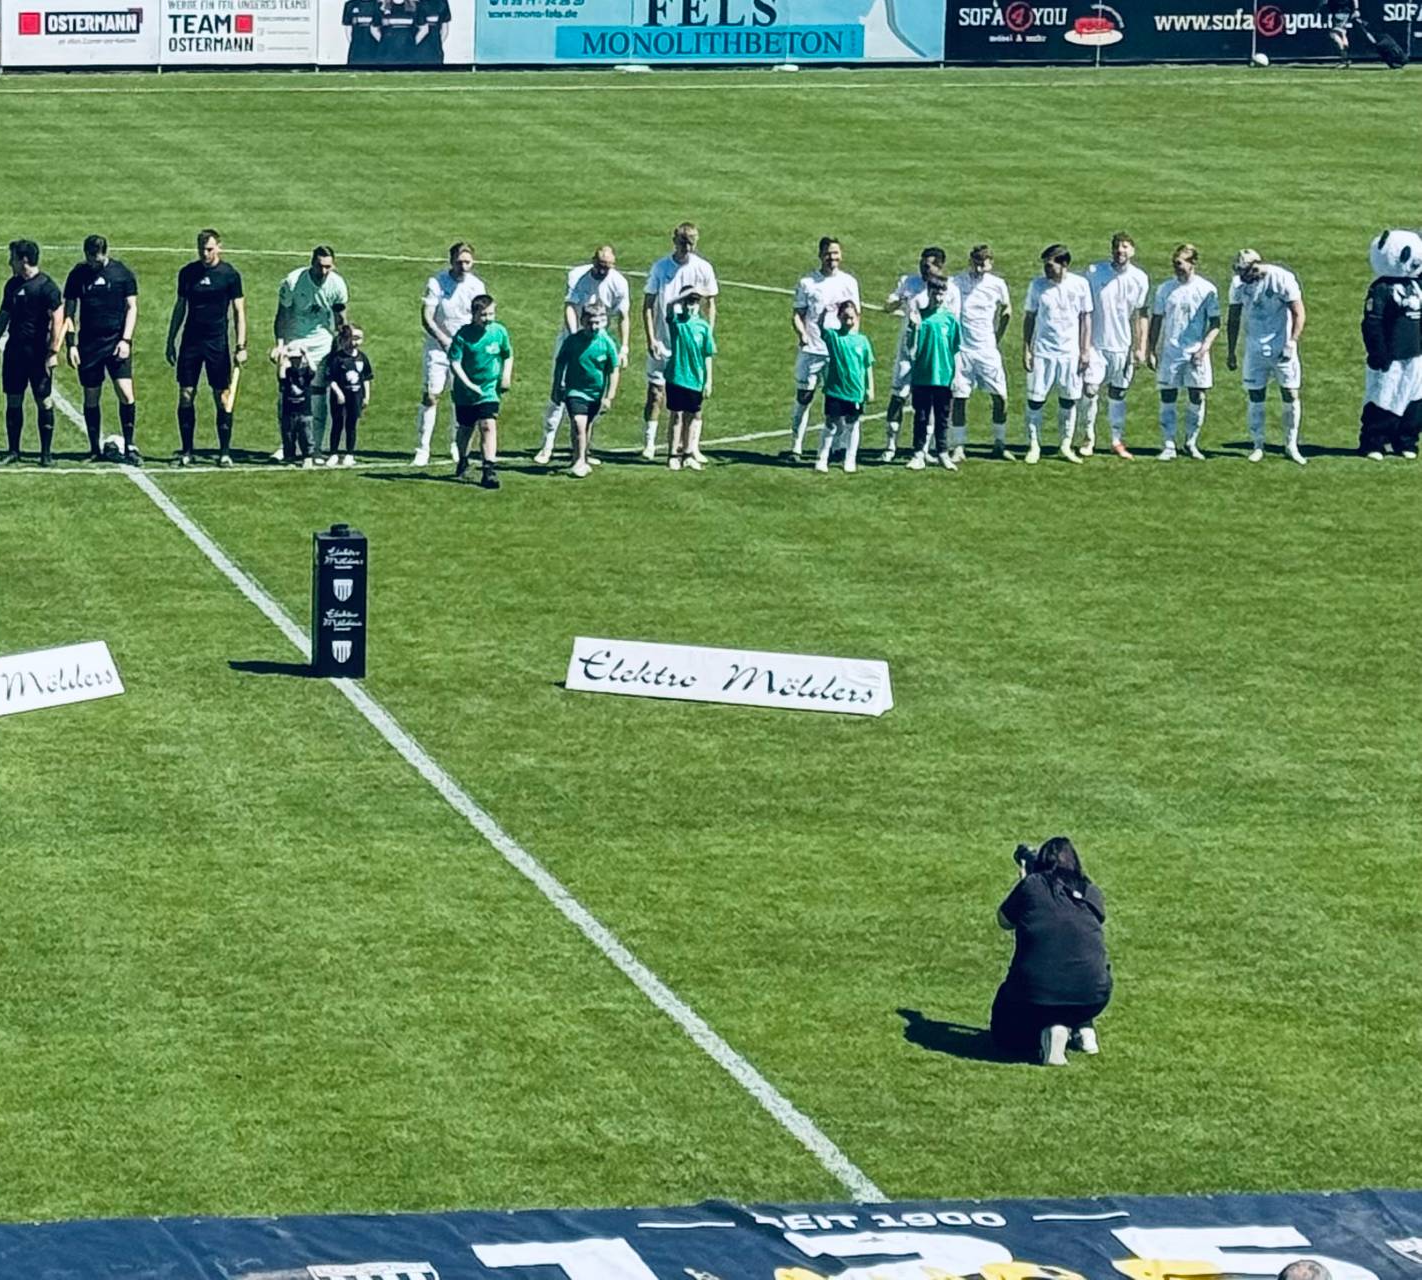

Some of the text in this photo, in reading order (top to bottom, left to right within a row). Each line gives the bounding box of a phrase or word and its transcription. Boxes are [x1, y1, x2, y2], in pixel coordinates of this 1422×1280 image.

[47, 14, 138, 33] OSTERMANN
[167, 14, 232, 34] TEAM
[643, 0, 778, 27] FELS
[168, 37, 254, 52] OSTERMANN
[581, 31, 843, 55] MONOLITHBETON
[0, 663, 113, 702] Mölders
[578, 650, 873, 704] Elektro Mölders
[871, 1212, 1007, 1232] 1900
